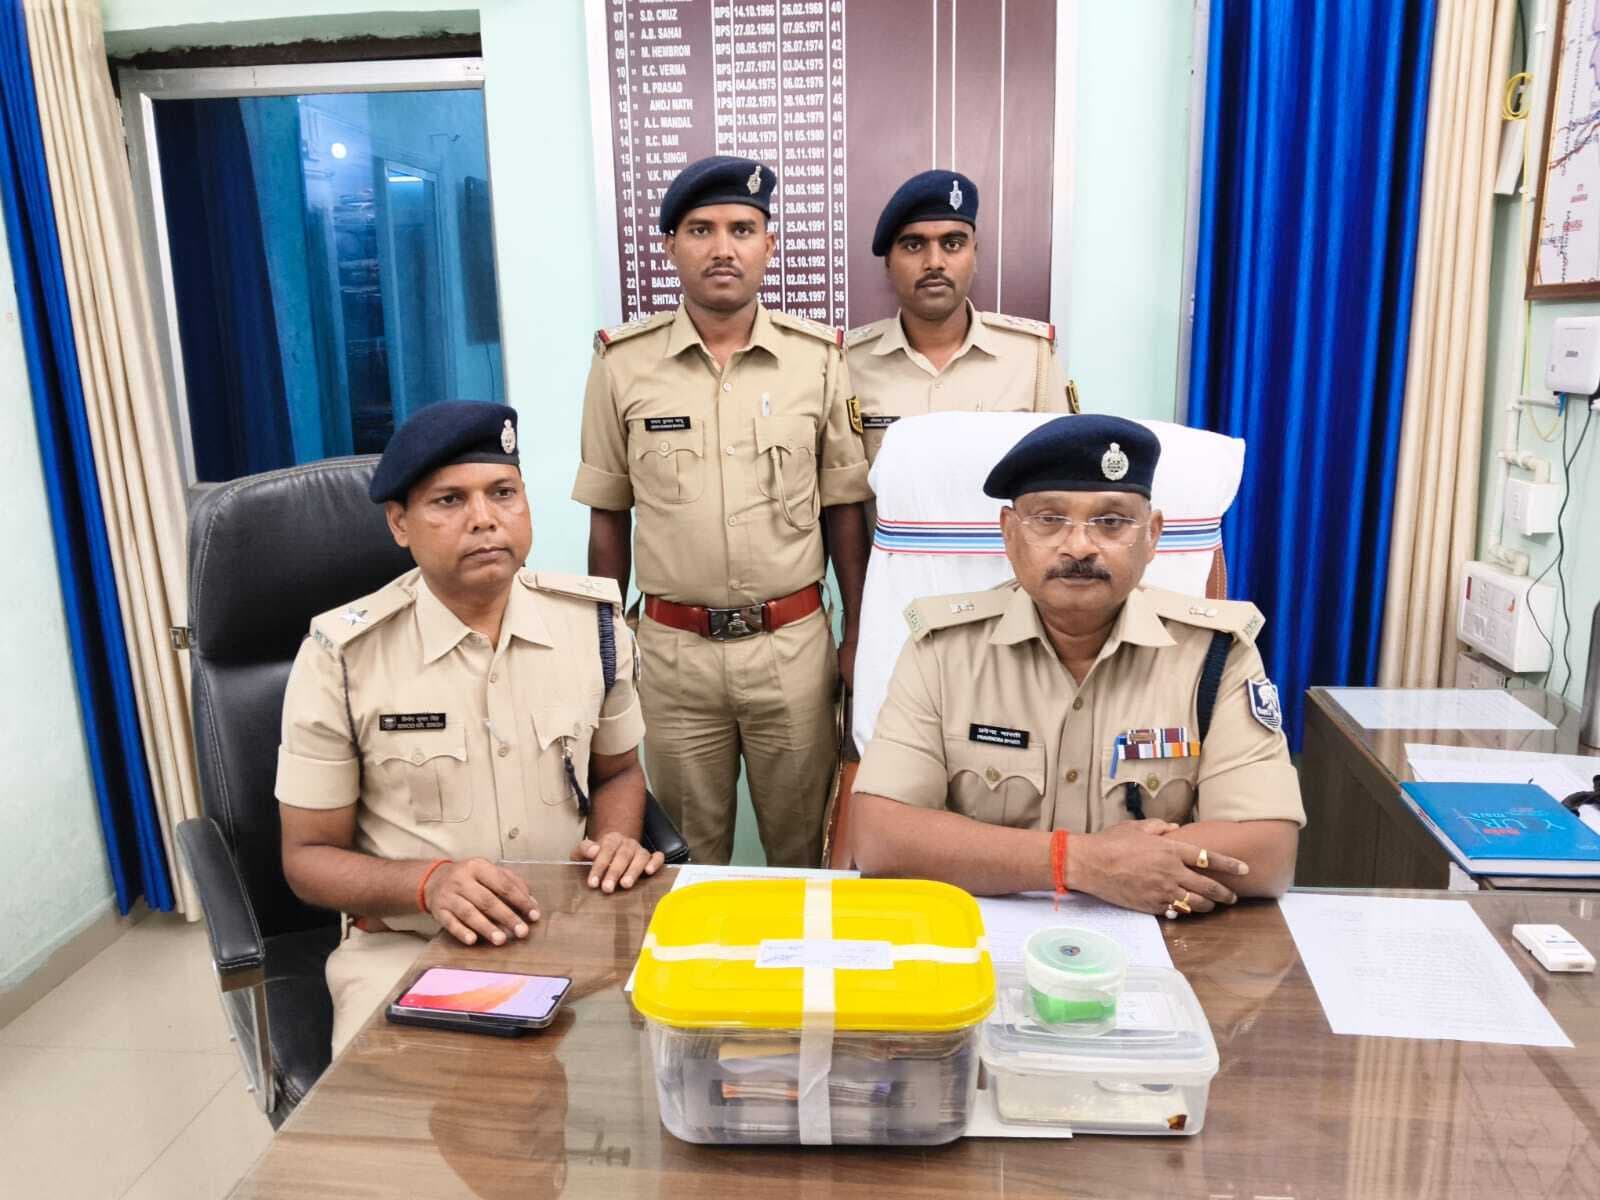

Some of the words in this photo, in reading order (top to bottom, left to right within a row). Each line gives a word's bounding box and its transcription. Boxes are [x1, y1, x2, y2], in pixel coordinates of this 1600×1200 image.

[613, 11, 623, 23] 07
[656, 8, 678, 20] CRUZ
[658, 27, 682, 39] SAHAI
[831, 21, 840, 32] 41
[616, 47, 625, 59] 09
[832, 39, 841, 50] 42
[658, 64, 686, 76] VERMA
[717, 64, 731, 75] BPS
[832, 58, 842, 70] 43
[652, 82, 683, 93] PRASAD
[717, 81, 732, 92] BPS
[832, 75, 842, 87] 44
[672, 99, 693, 110] NATH
[833, 93, 842, 105] 45
[619, 118, 629, 130] 13
[660, 117, 692, 128] MANDAL
[620, 136, 629, 147] 14
[833, 130, 842, 141] 47
[621, 154, 630, 164] 15
[663, 152, 687, 164] SINGH
[622, 171, 631, 182] 16
[834, 165, 843, 176] 49
[623, 189, 631, 200] 17
[834, 183, 843, 194] 50
[834, 201, 843, 213] 51
[624, 226, 632, 236] 19
[833, 220, 843, 231] 52
[624, 243, 634, 254] 20
[834, 238, 843, 249] 53
[626, 261, 635, 271] 21
[786, 256, 825, 267] 15.10.1992
[834, 256, 843, 267] 54
[626, 278, 635, 288] 22
[652, 277, 680, 288] BALDEO
[786, 273, 825, 285] 02.02.1994
[834, 274, 844, 284] 55
[628, 295, 636, 306] 23
[652, 294, 678, 304] SHITAL
[834, 291, 844, 302] 56
[629, 312, 637, 322] 24
[835, 308, 844, 319] 57
